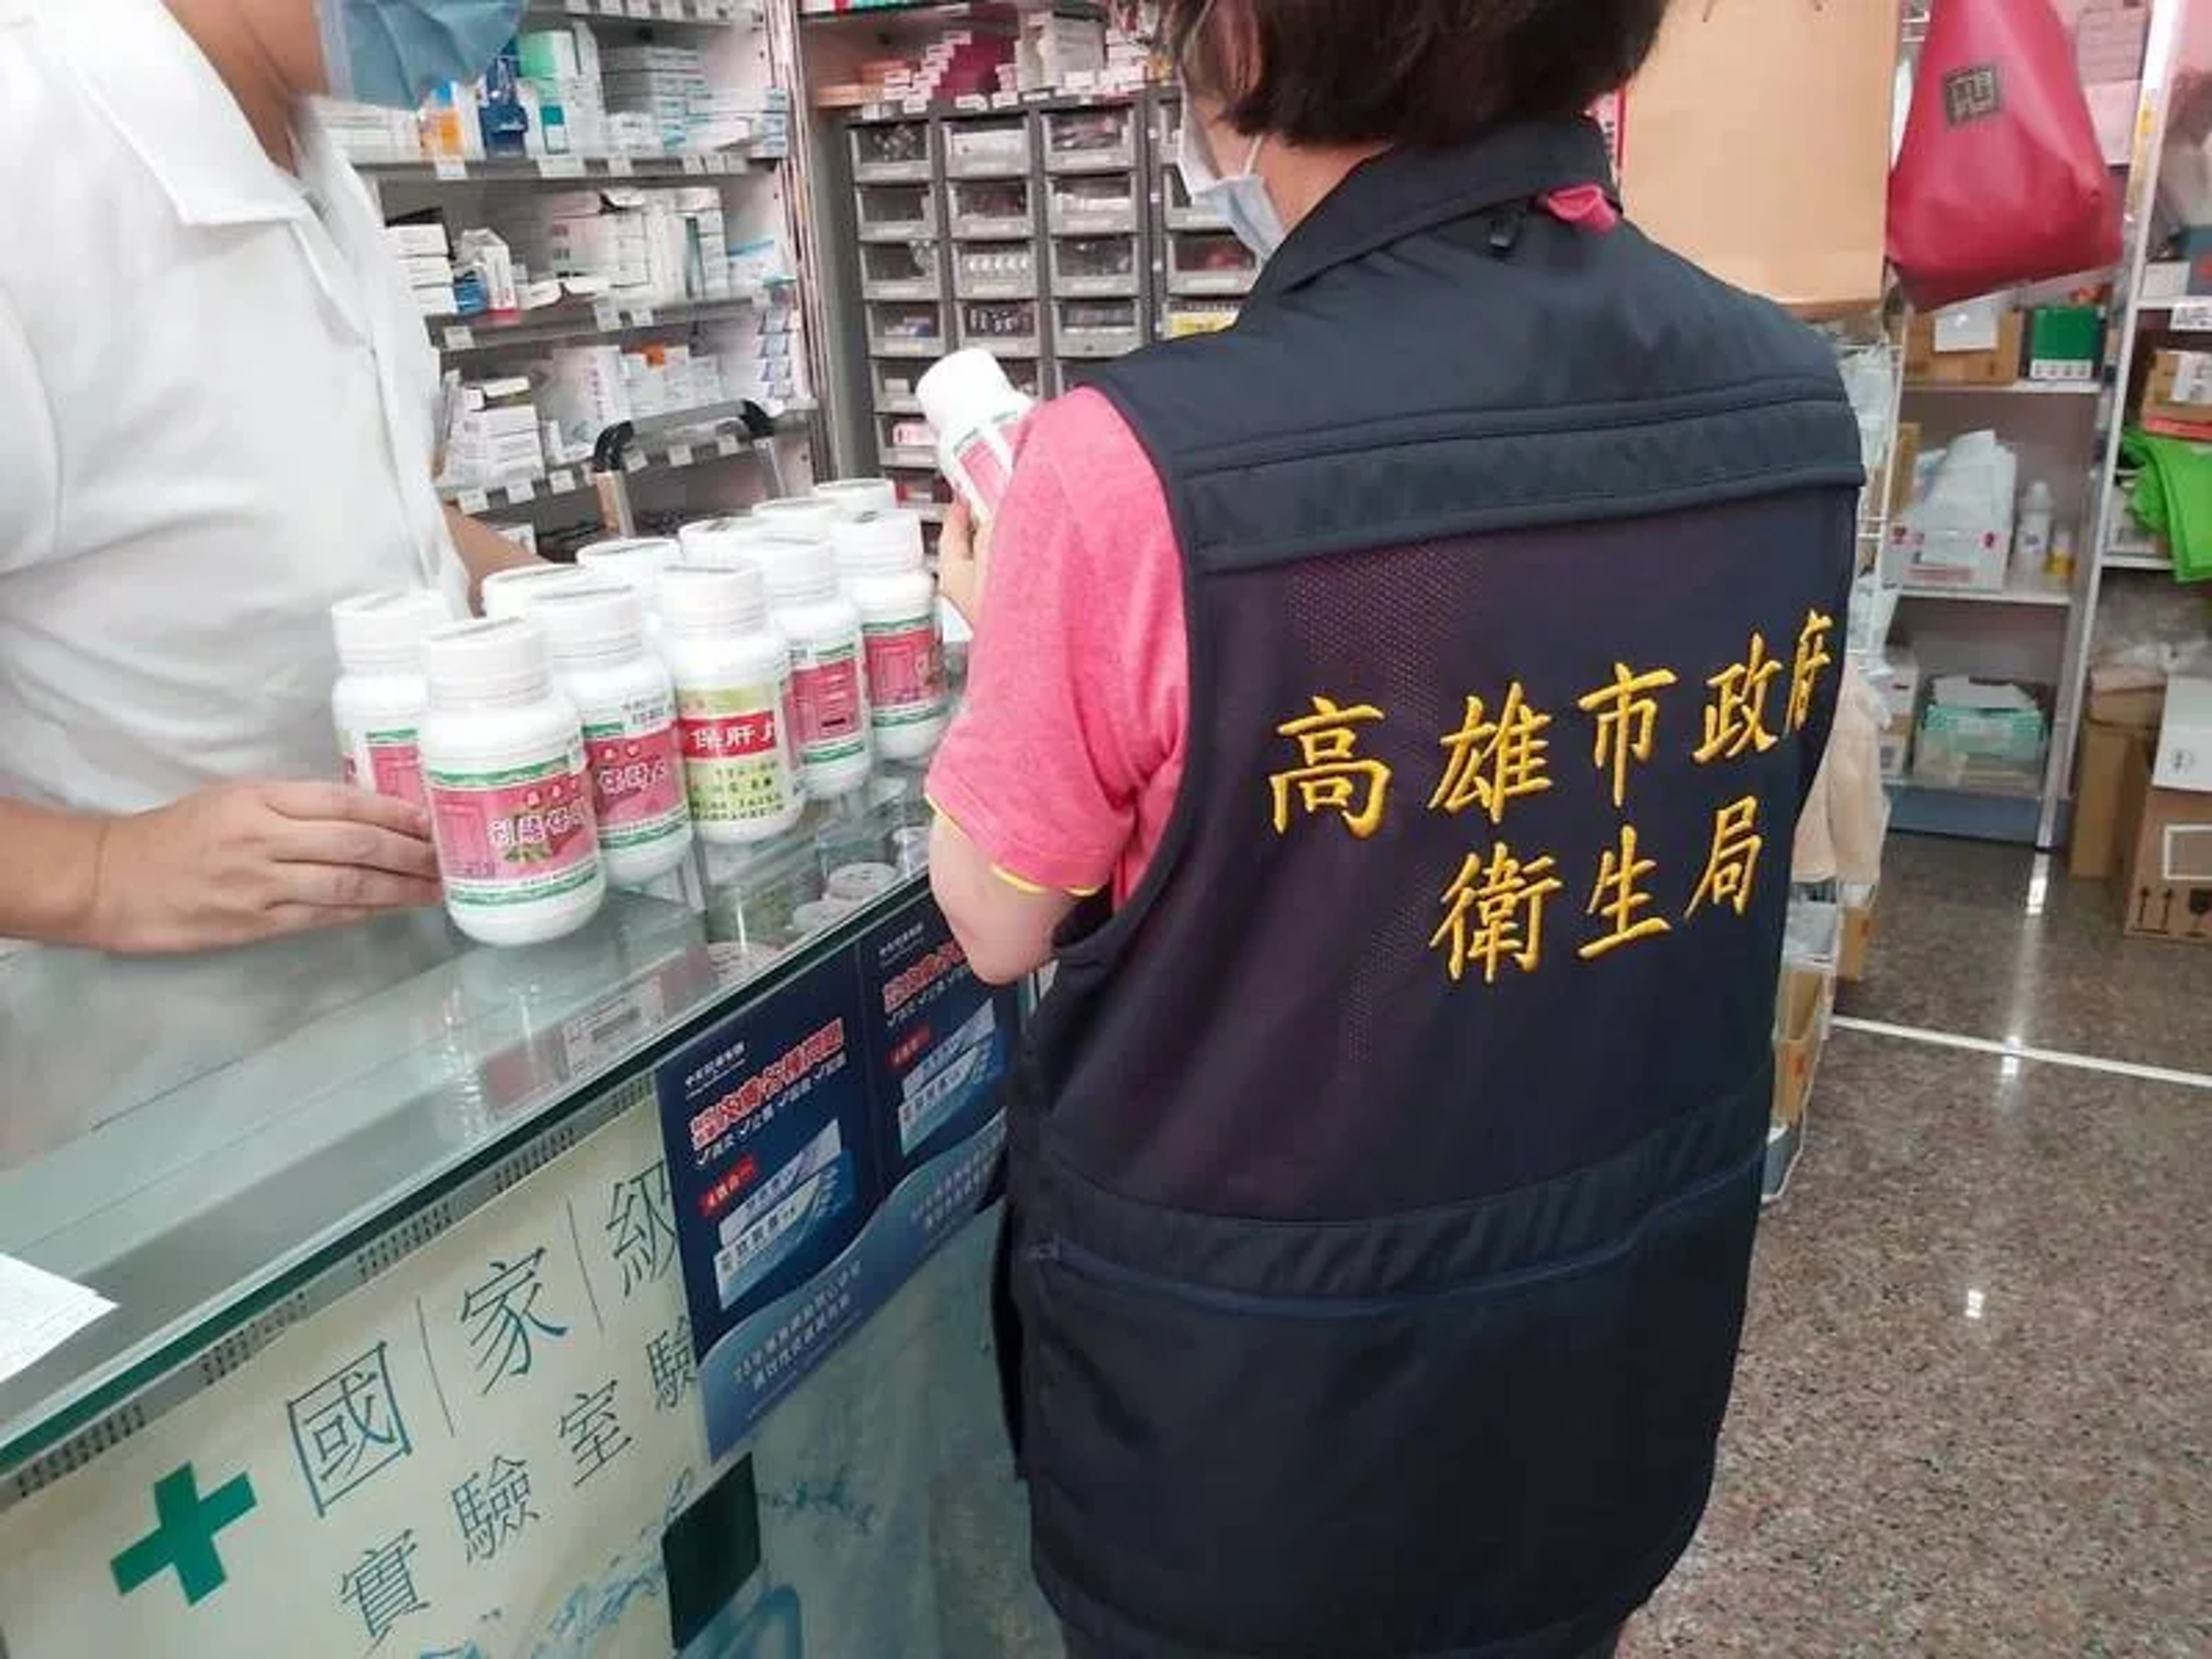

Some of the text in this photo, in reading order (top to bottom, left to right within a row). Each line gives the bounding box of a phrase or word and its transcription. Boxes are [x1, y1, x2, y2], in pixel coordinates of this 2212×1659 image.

[1268, 607, 1833, 839] 高雄市政府
[1430, 795, 1762, 983] 衛生局
[287, 1159, 677, 1519] 國家級
